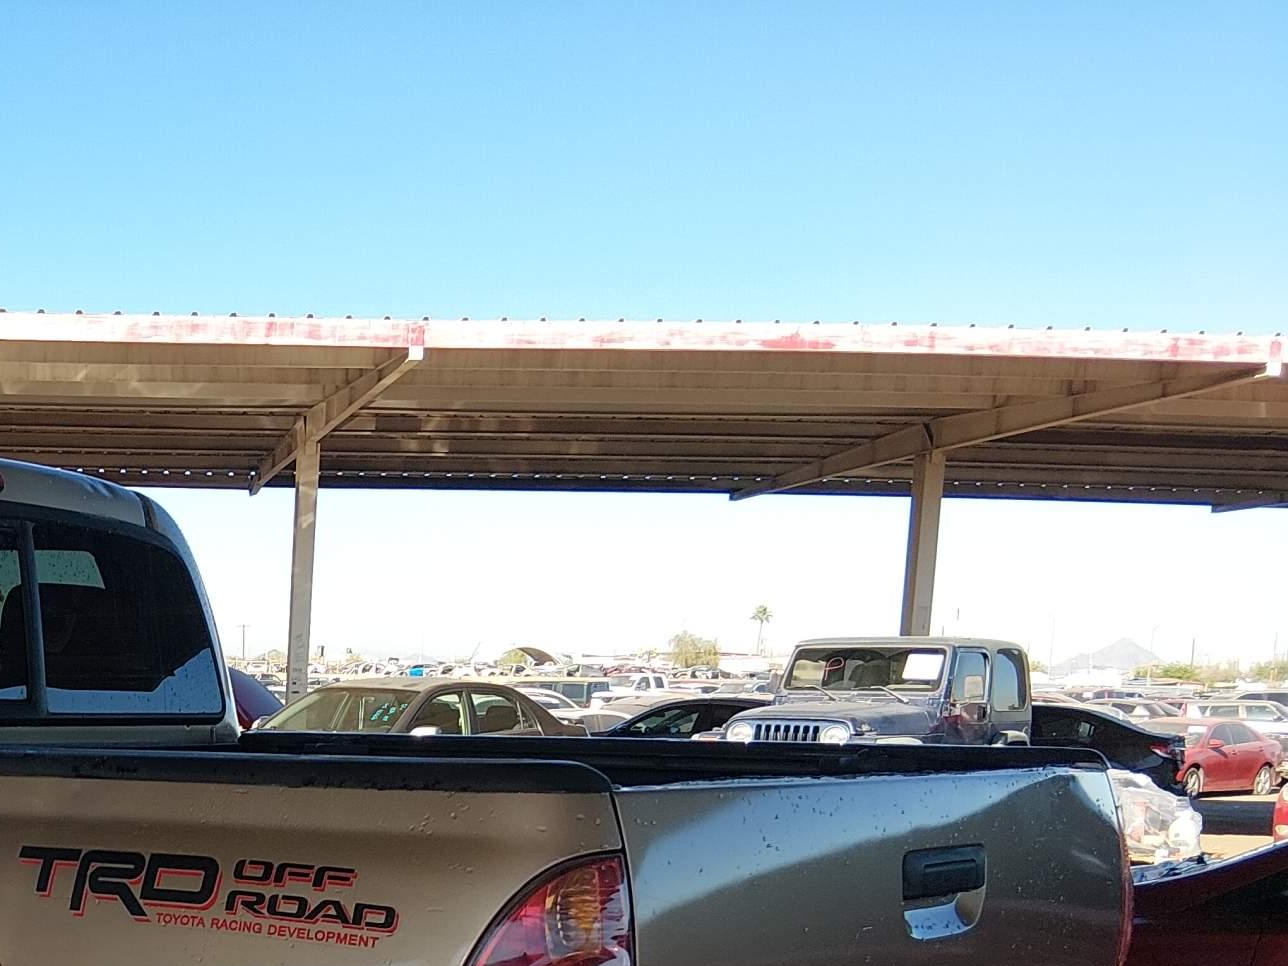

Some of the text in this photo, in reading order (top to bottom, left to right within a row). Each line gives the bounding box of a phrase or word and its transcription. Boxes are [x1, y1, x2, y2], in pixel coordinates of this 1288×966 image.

[18, 845, 224, 922] TRD
[231, 858, 359, 893] OFF
[156, 912, 381, 950] TOYOTA RACING DEVELOPMENT
[224, 889, 401, 938] ROAD
